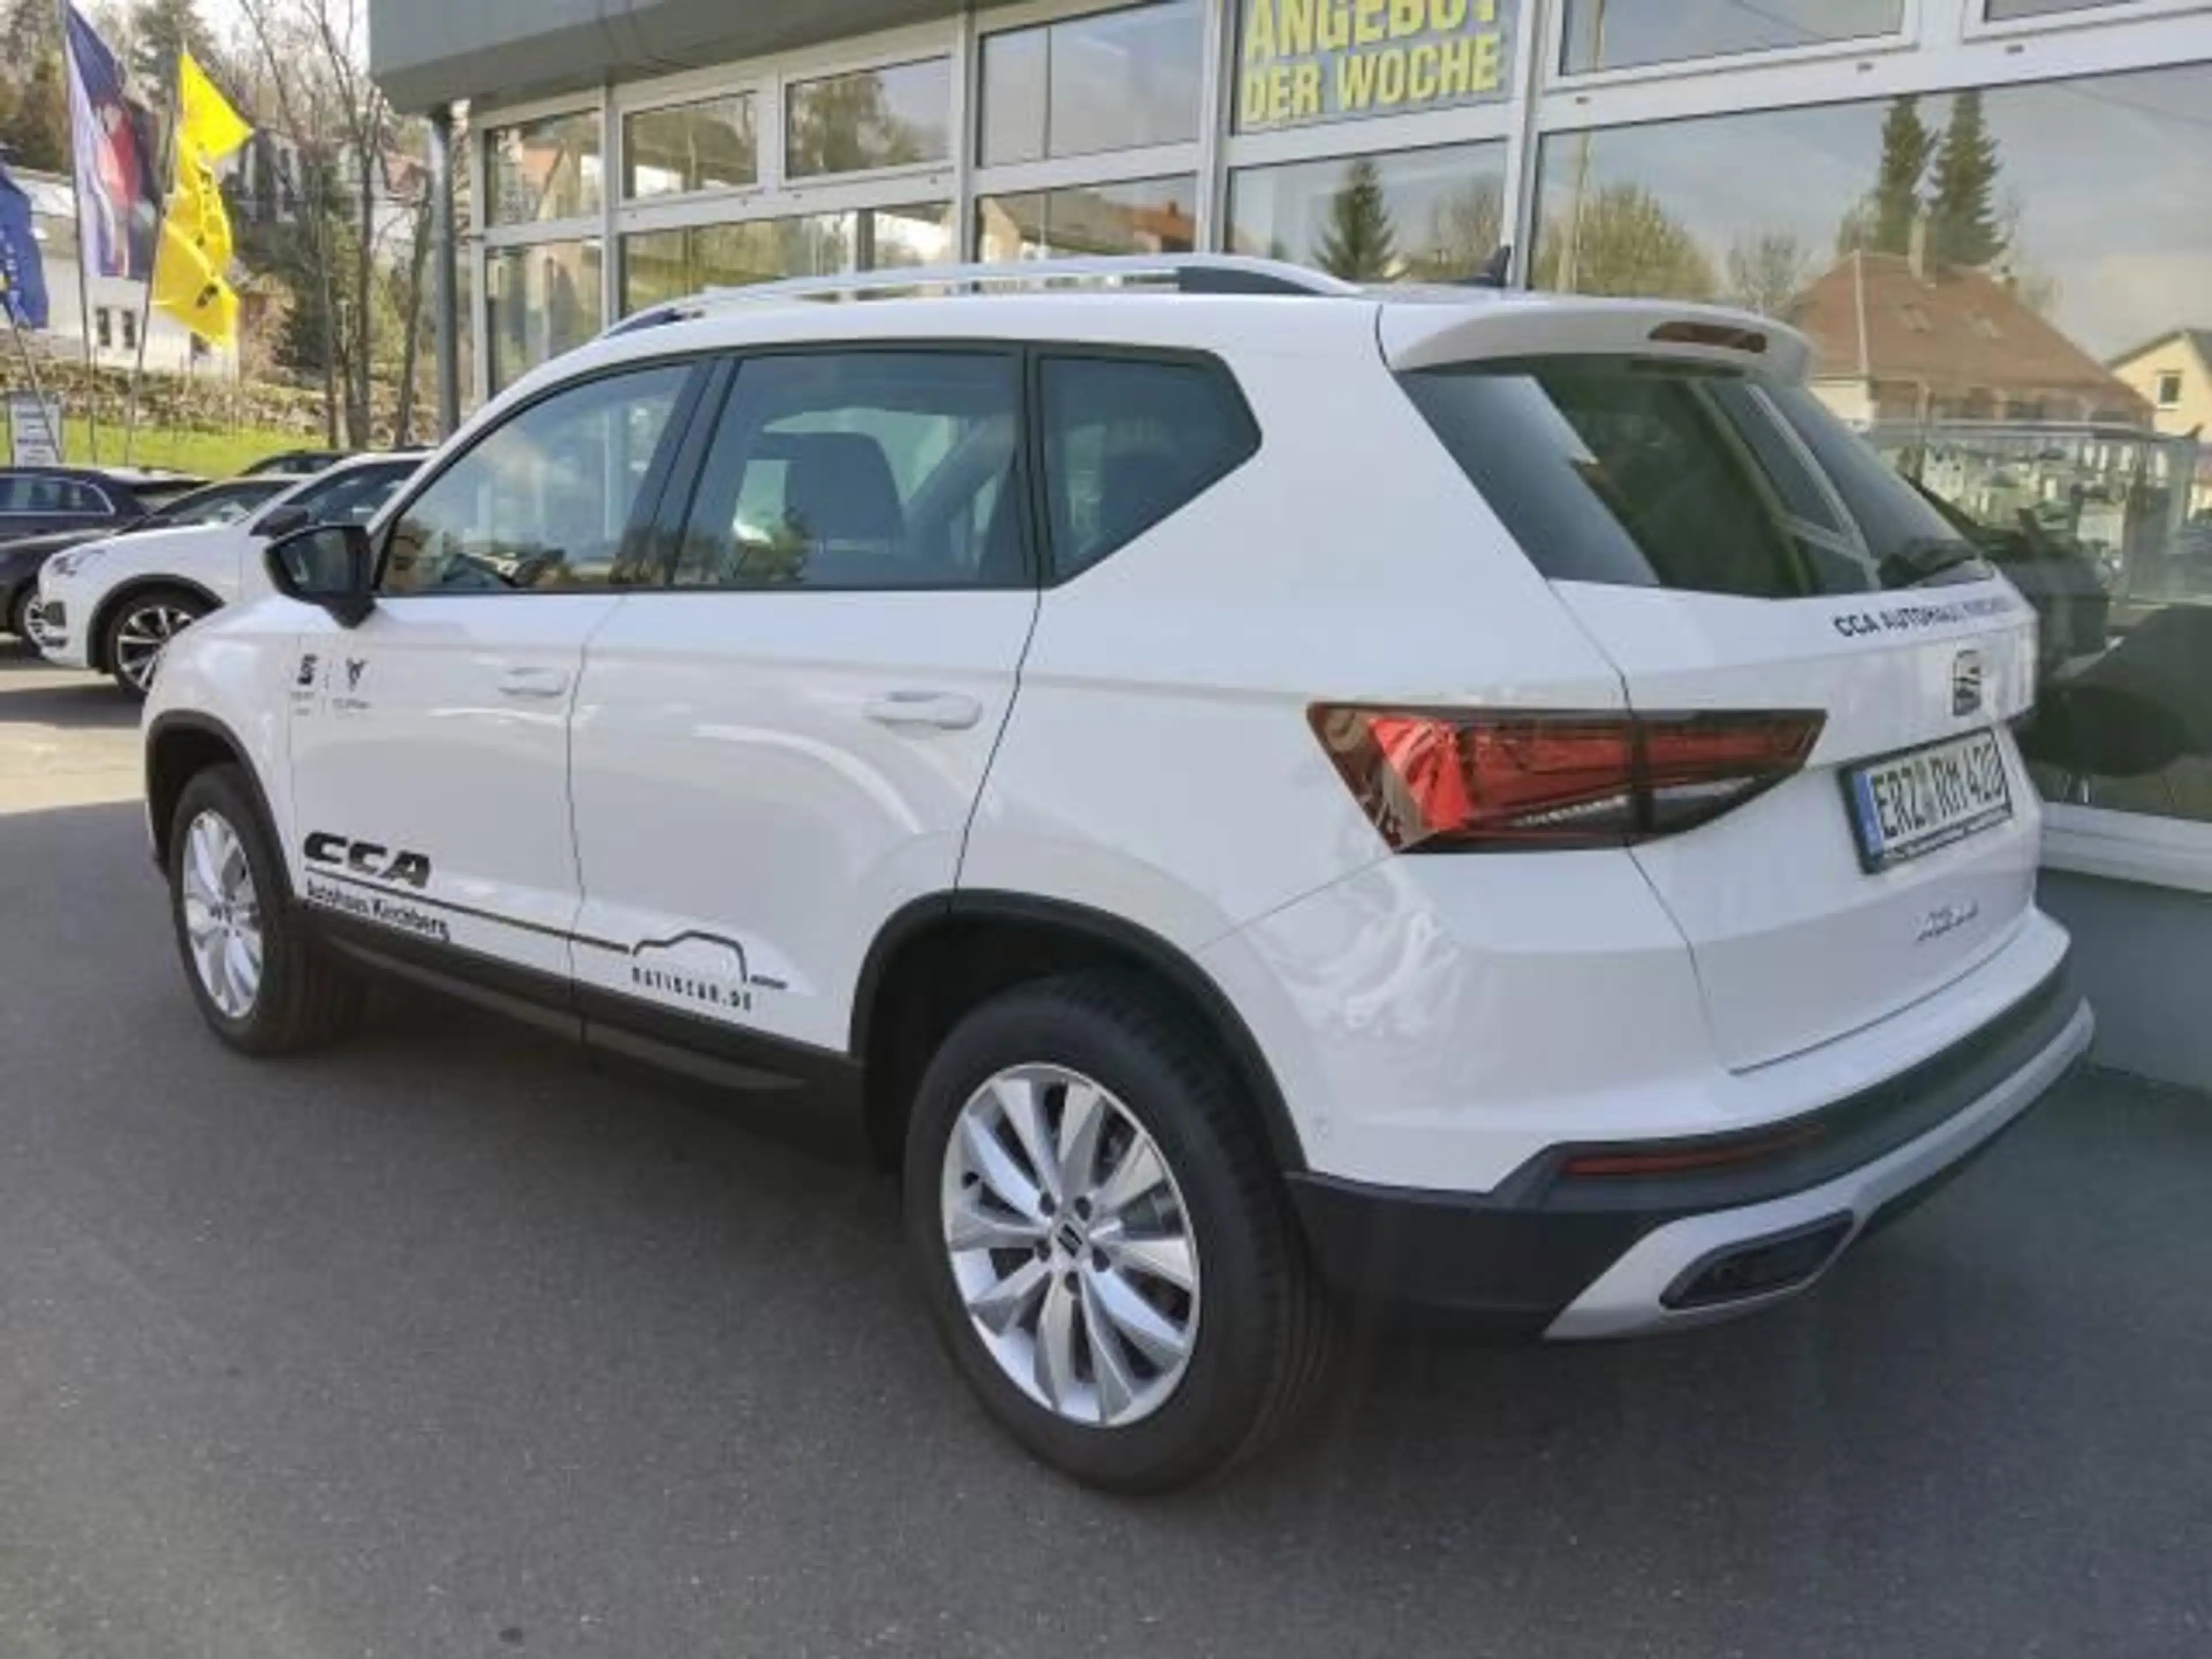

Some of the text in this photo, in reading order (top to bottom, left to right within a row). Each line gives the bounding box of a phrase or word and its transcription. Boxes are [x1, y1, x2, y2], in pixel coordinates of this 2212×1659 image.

[1242, 32, 1499, 122] DER WOCHE
[1834, 612, 1880, 637] CCA
[1872, 766, 1926, 838] ERZ
[304, 832, 430, 889] CCA
